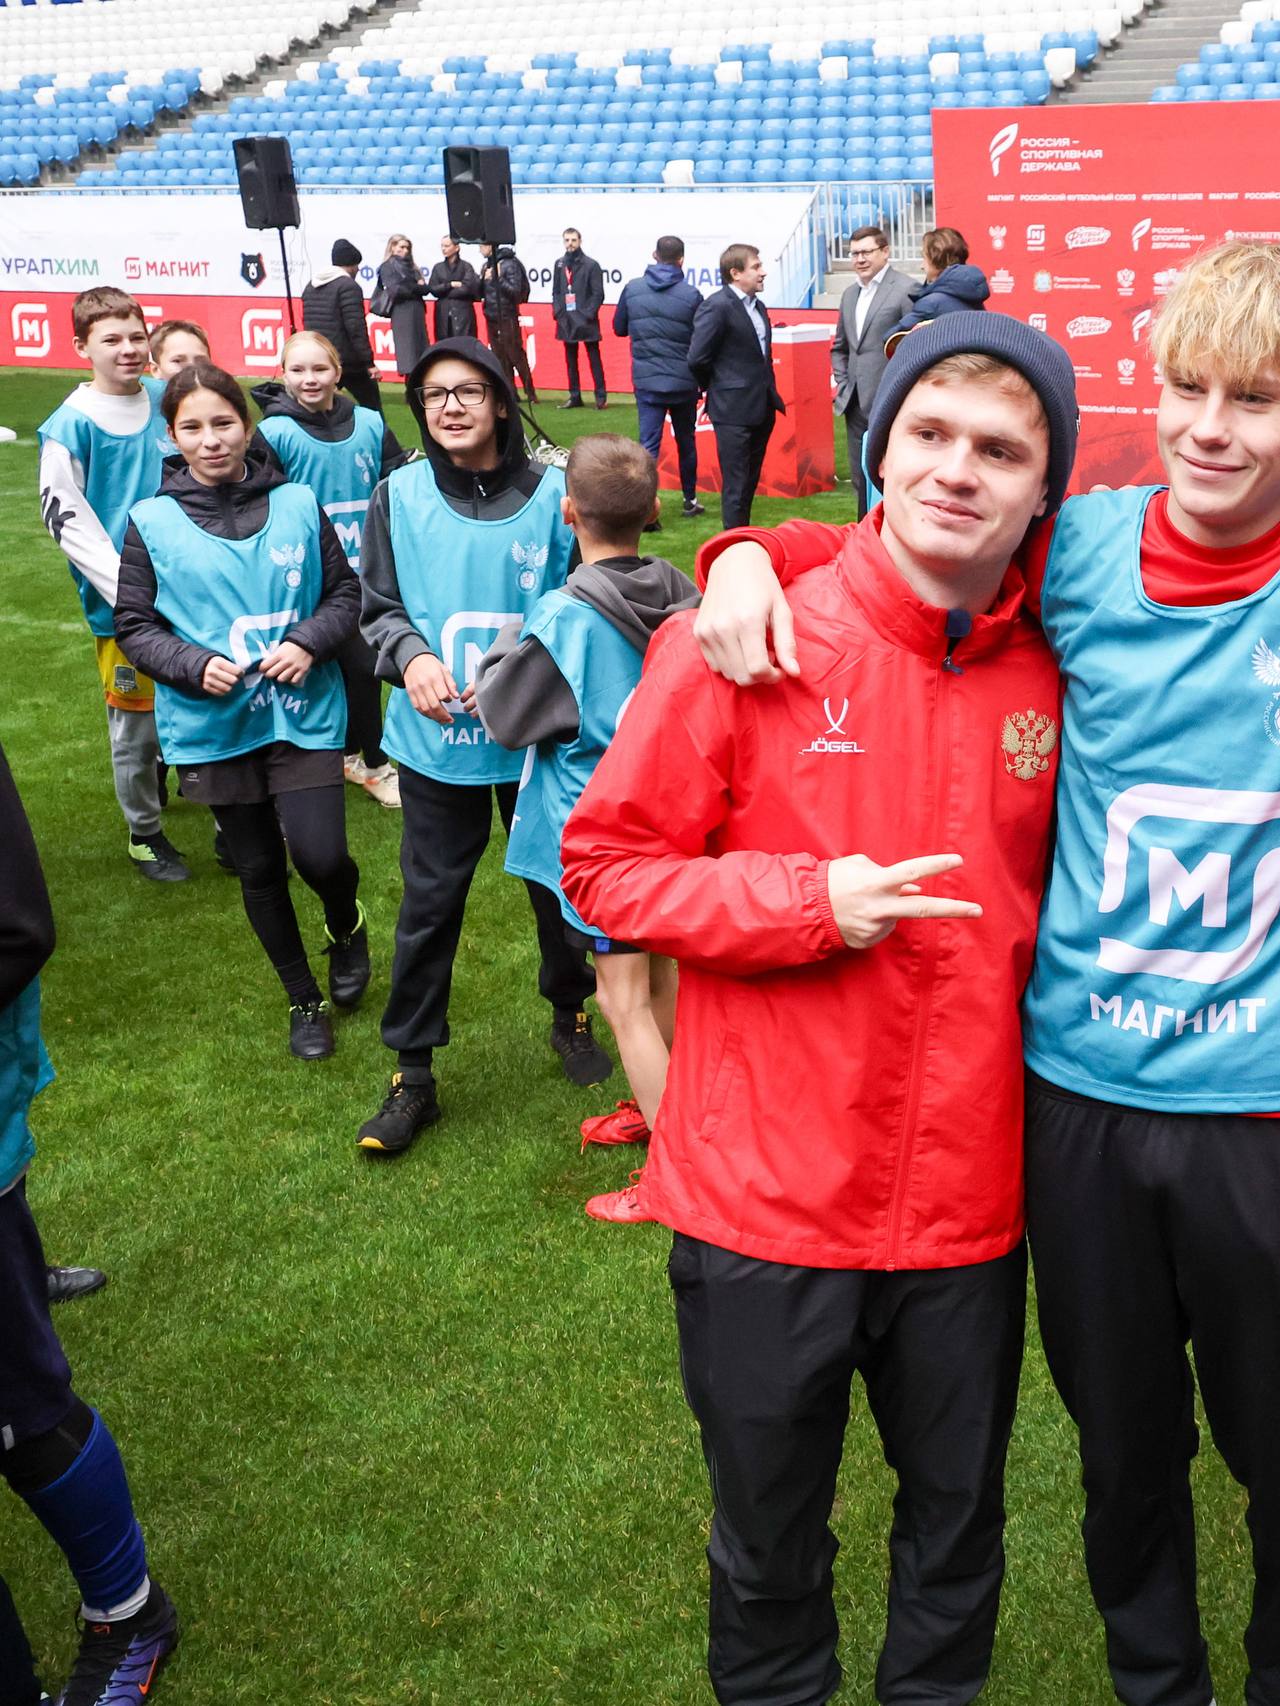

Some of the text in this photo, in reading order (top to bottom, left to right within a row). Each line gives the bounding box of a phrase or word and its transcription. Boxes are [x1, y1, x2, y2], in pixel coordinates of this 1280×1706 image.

[1020, 137, 1071, 148] РОССИЯ
[1020, 149, 1104, 160] СПОРТИВНАЯ
[1020, 161, 1081, 173] ДЕРЖАВА
[1, 257, 99, 277] УРАЛХИМ
[146, 261, 210, 277] МАГНИТ
[801, 737, 866, 753] JÖGEL
[1089, 992, 1267, 1040] МАГНИТ
